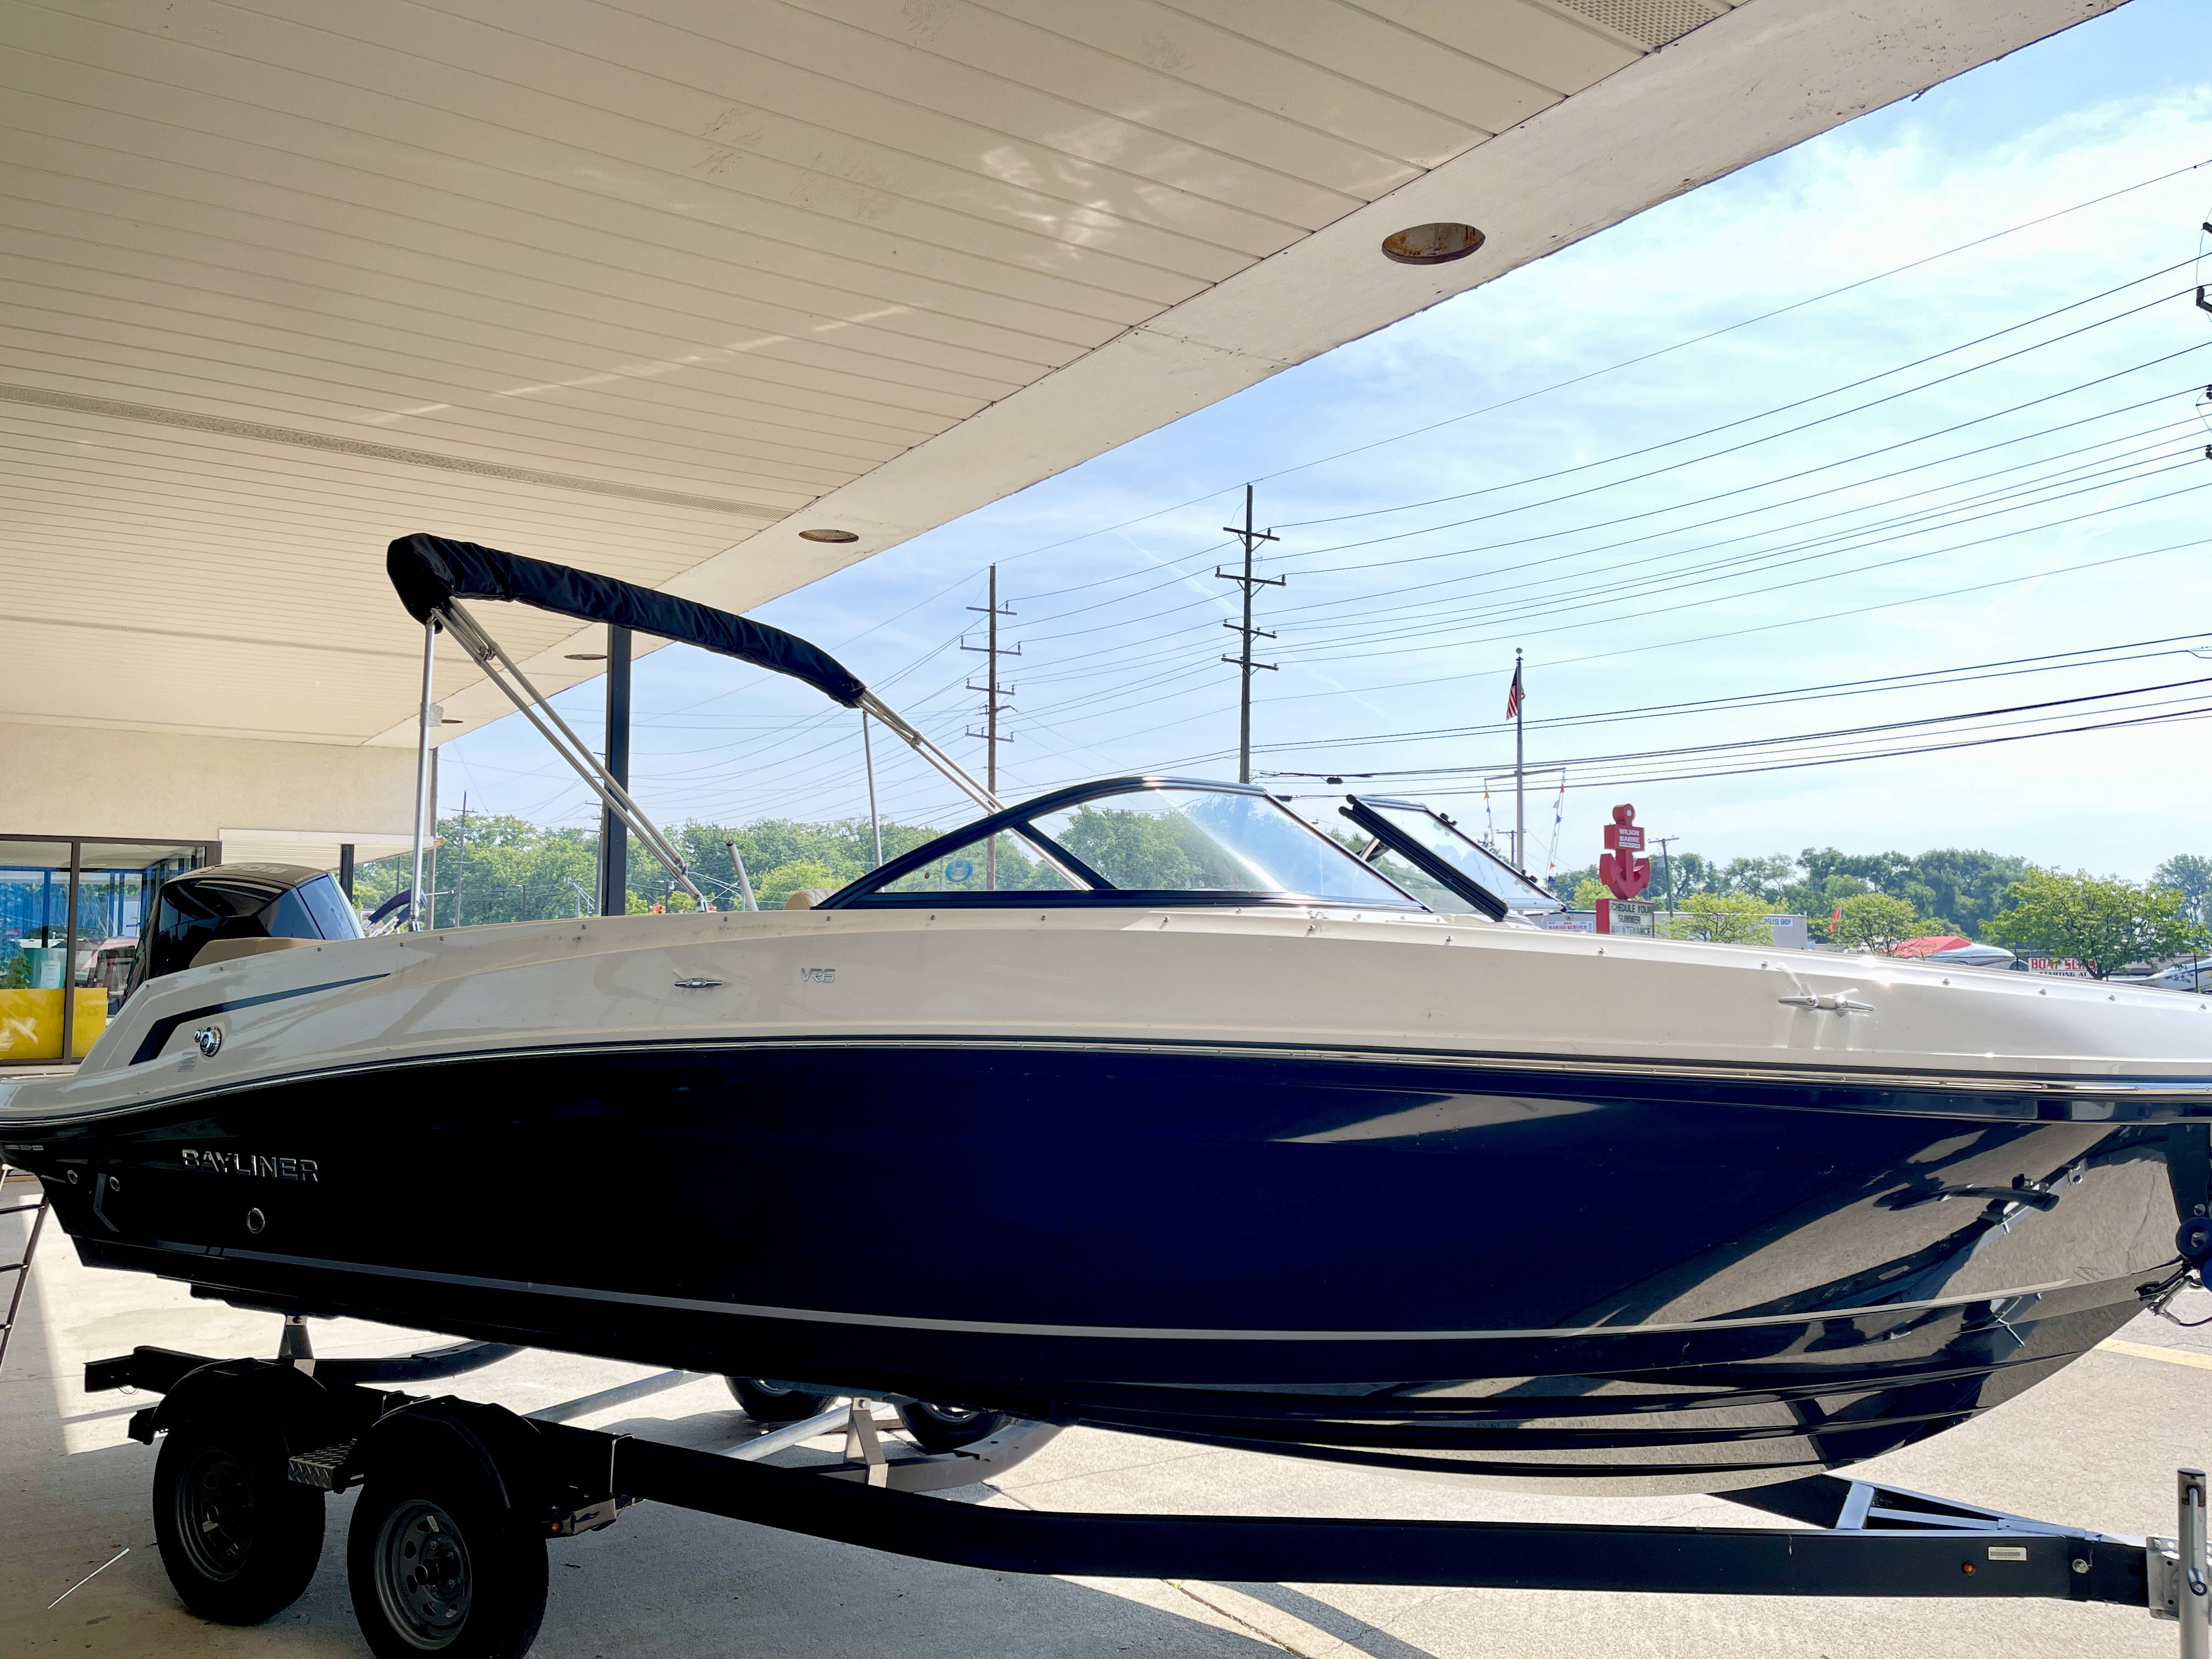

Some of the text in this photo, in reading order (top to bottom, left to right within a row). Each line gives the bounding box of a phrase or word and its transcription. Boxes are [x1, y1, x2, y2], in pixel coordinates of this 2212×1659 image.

[1610, 902, 1654, 914] SCHEDULE YOUR
[1618, 915, 1641, 924] SUMMER
[1611, 925, 1651, 936] MAINTENANCE
[802, 968, 836, 983] VR6
[182, 1149, 318, 1182] BAYLINER
